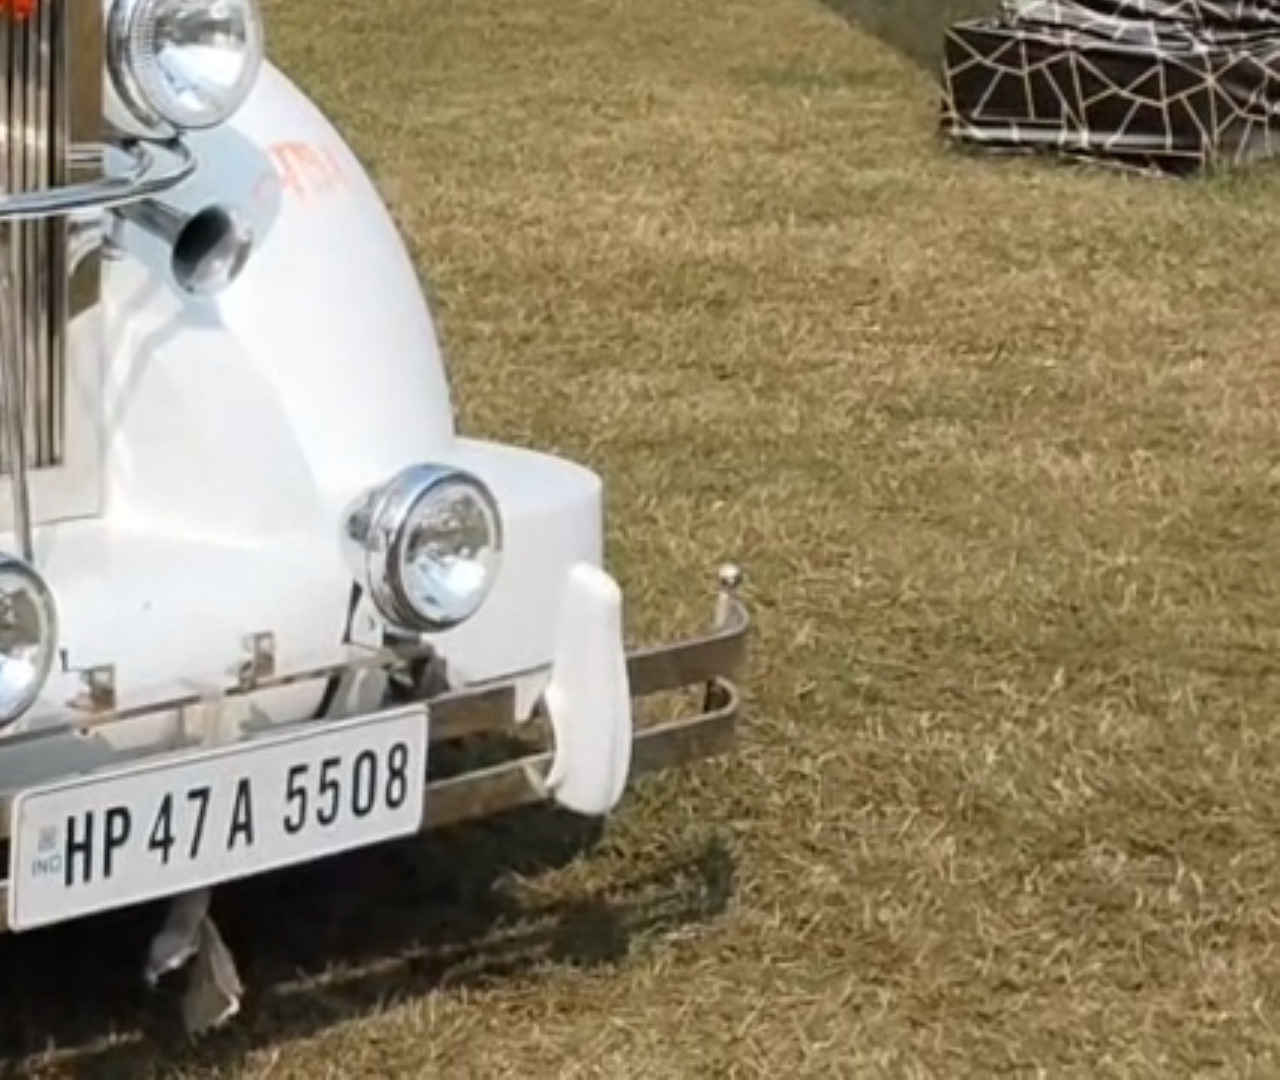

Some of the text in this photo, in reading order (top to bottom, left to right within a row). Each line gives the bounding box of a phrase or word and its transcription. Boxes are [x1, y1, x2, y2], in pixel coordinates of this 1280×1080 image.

[65, 742, 409, 888] HP 47 A 5508
